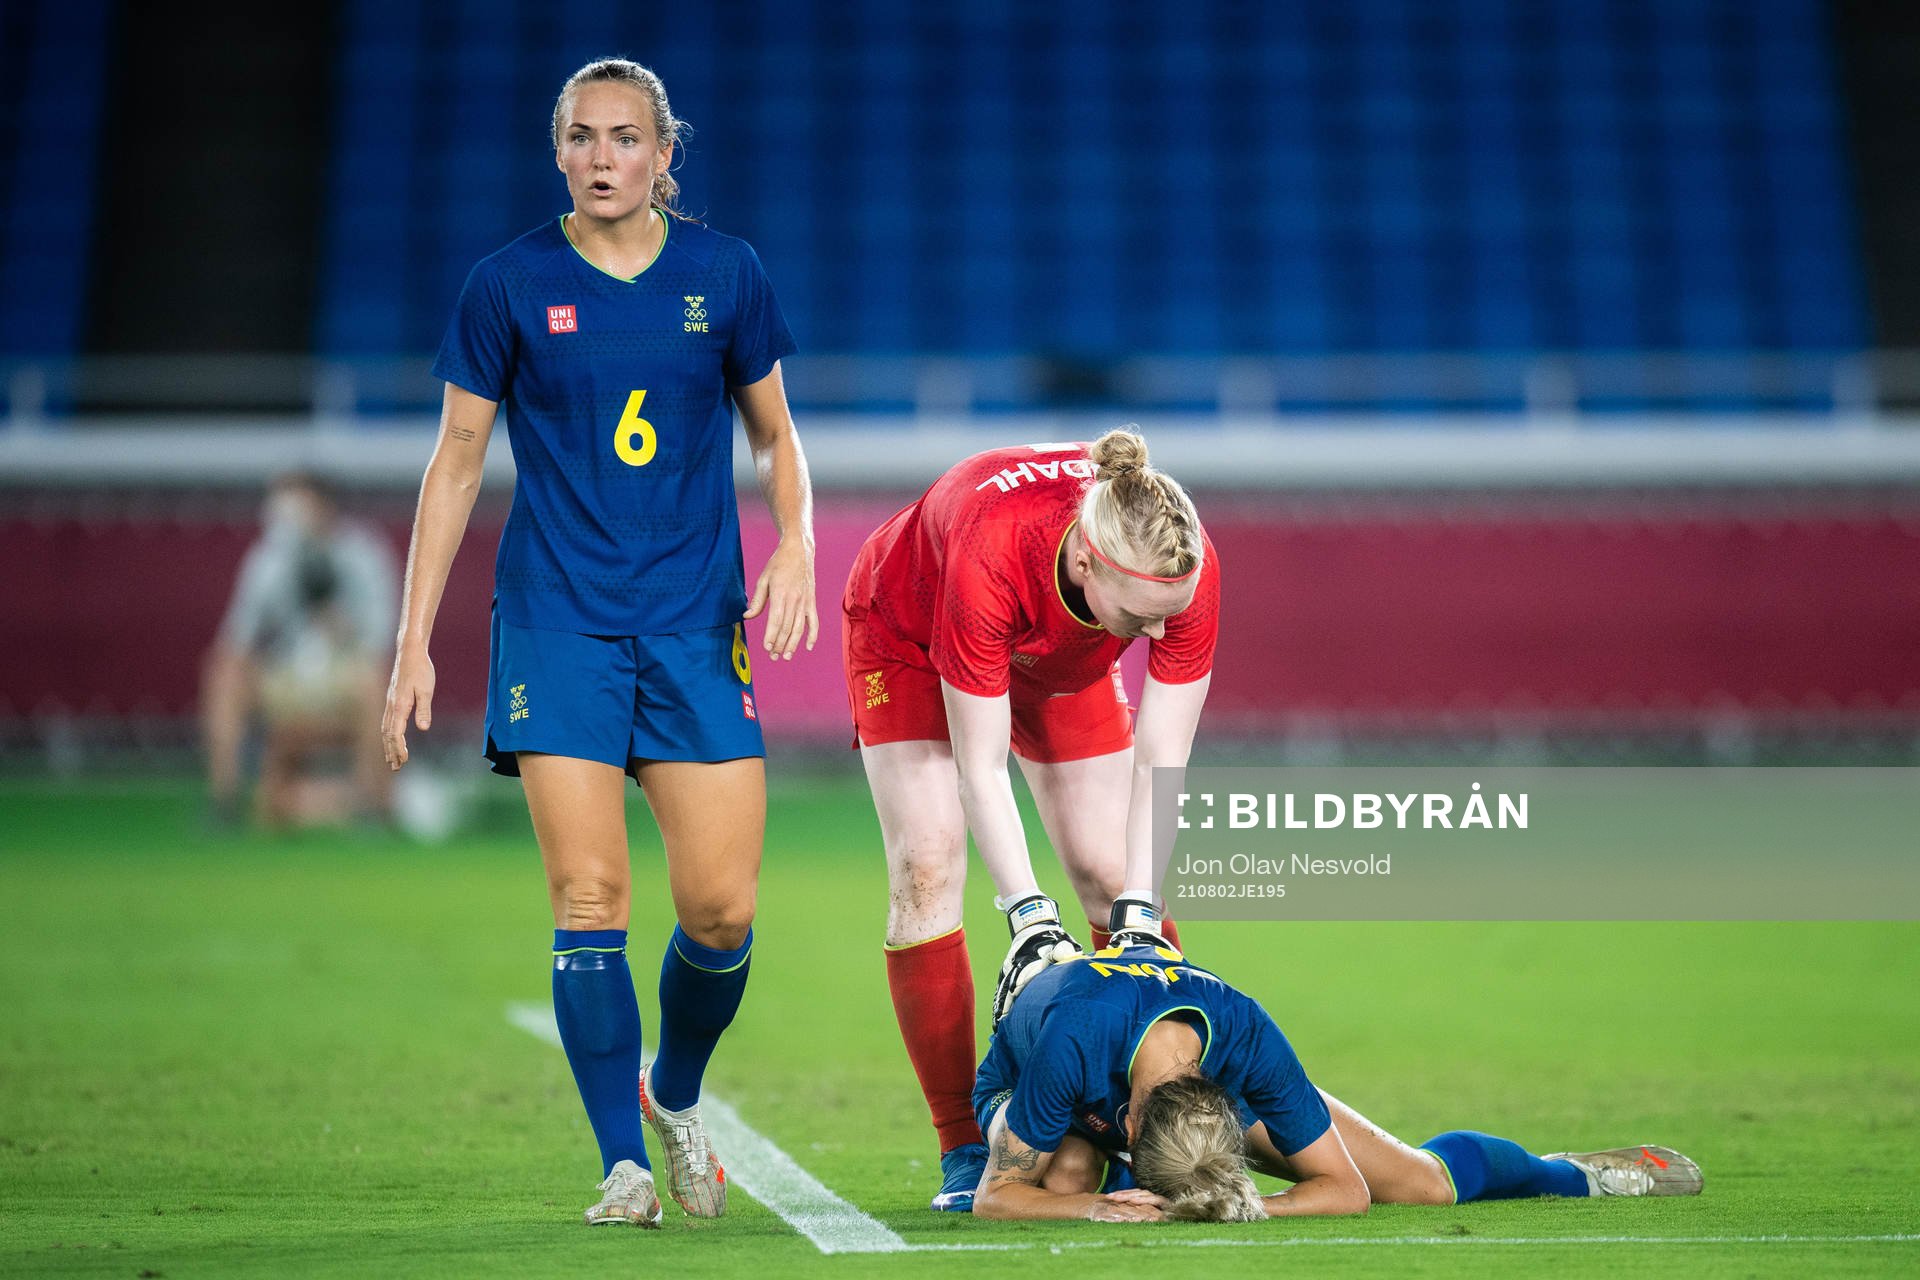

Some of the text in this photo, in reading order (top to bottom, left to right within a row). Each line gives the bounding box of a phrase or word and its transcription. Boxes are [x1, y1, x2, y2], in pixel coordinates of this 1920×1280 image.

[551, 308, 571, 319] UNI
[551, 319, 574, 331] QLO
[684, 321, 709, 332] SWE
[614, 389, 657, 467] 6
[732, 622, 751, 684] 6
[866, 692, 890, 709] SWE
[510, 708, 529, 723] SWE
